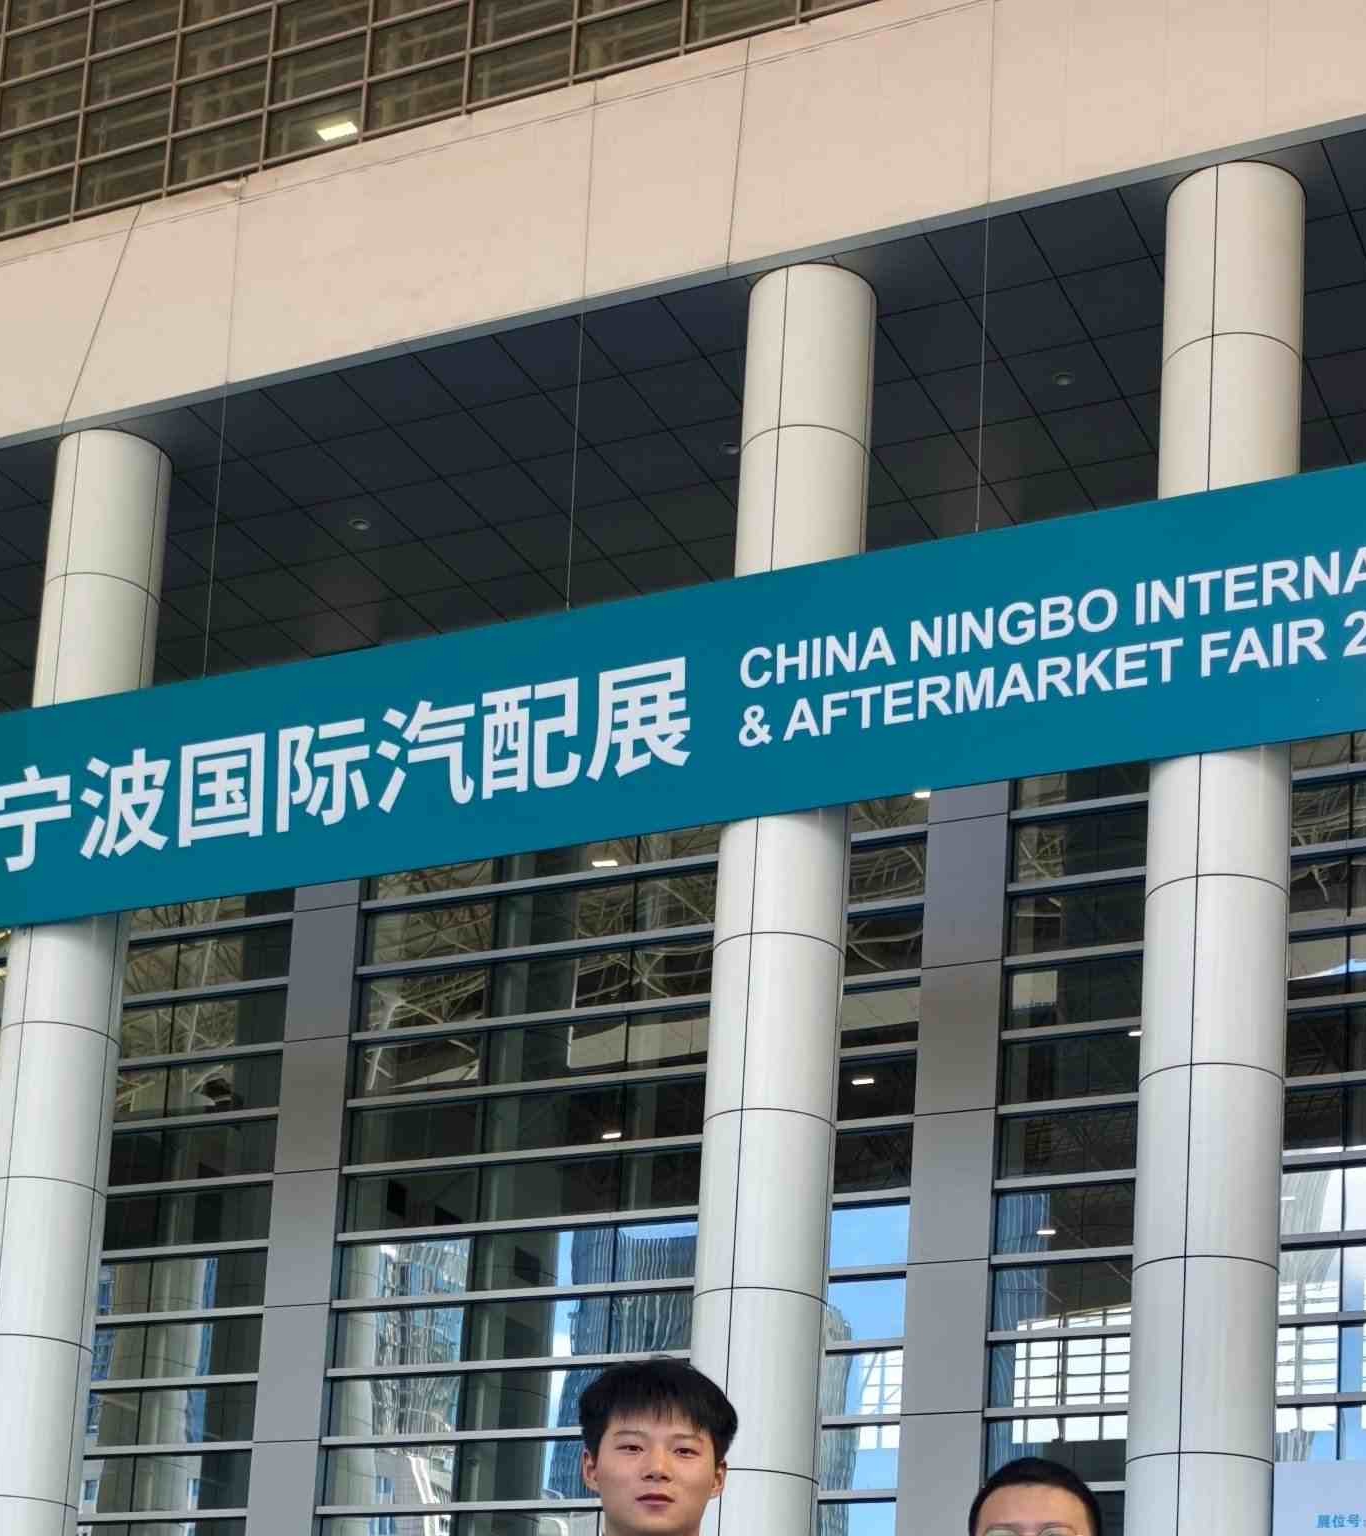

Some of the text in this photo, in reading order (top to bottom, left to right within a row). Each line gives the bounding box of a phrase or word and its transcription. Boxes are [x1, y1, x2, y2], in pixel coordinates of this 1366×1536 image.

[738, 704, 773, 748] &
[782, 638, 1184, 744] AFTERMARKET
[1200, 617, 1326, 678] FAIR
[739, 625, 897, 690] CHINA
[909, 587, 1119, 663] NINGBO
